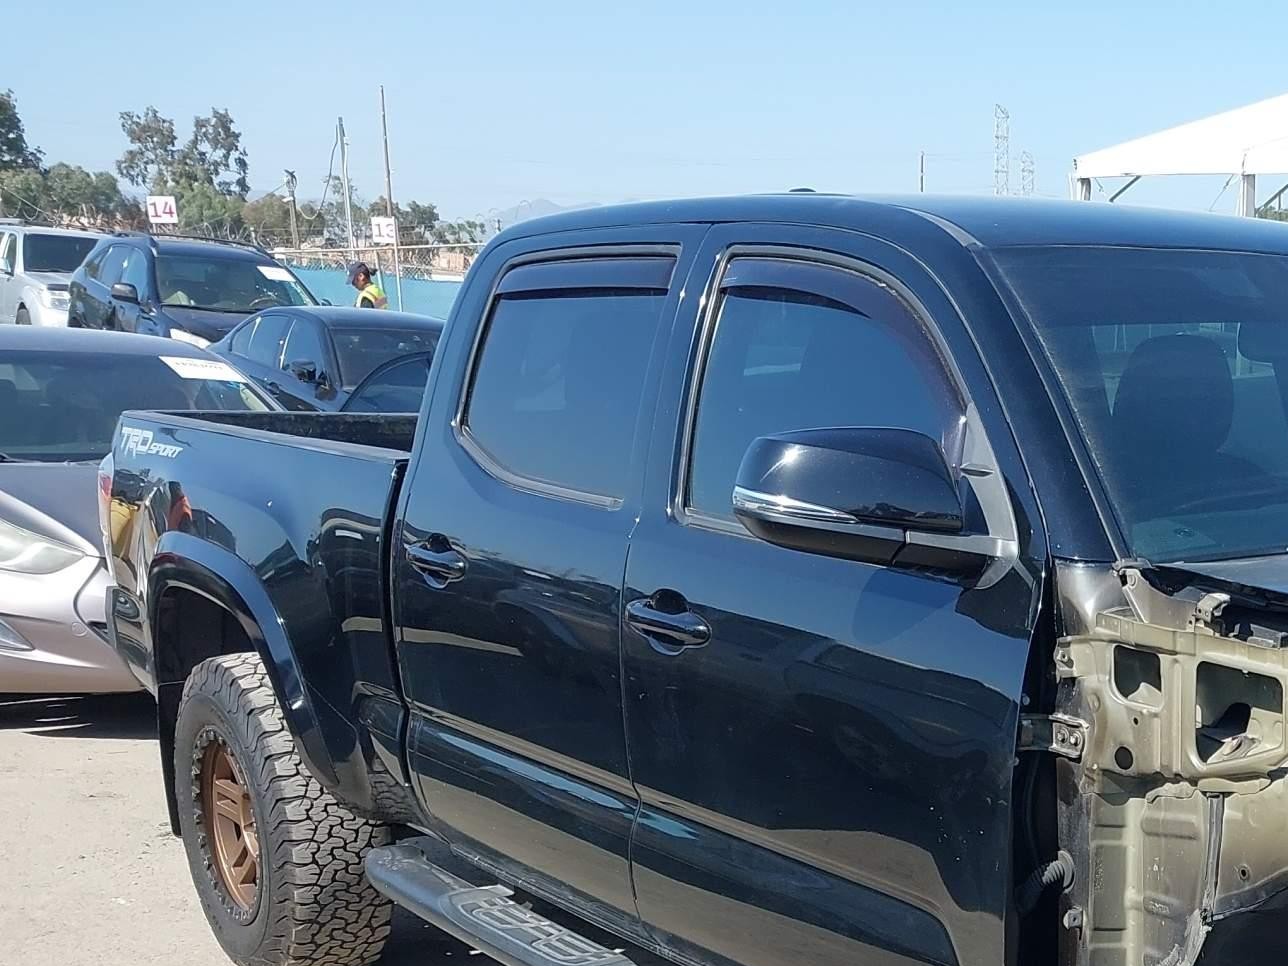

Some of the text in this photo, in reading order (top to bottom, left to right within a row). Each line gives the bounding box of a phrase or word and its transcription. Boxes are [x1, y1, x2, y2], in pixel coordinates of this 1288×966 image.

[149, 201, 175, 218] 14
[374, 223, 394, 239] 13
[121, 426, 183, 458] TRD SPORT
